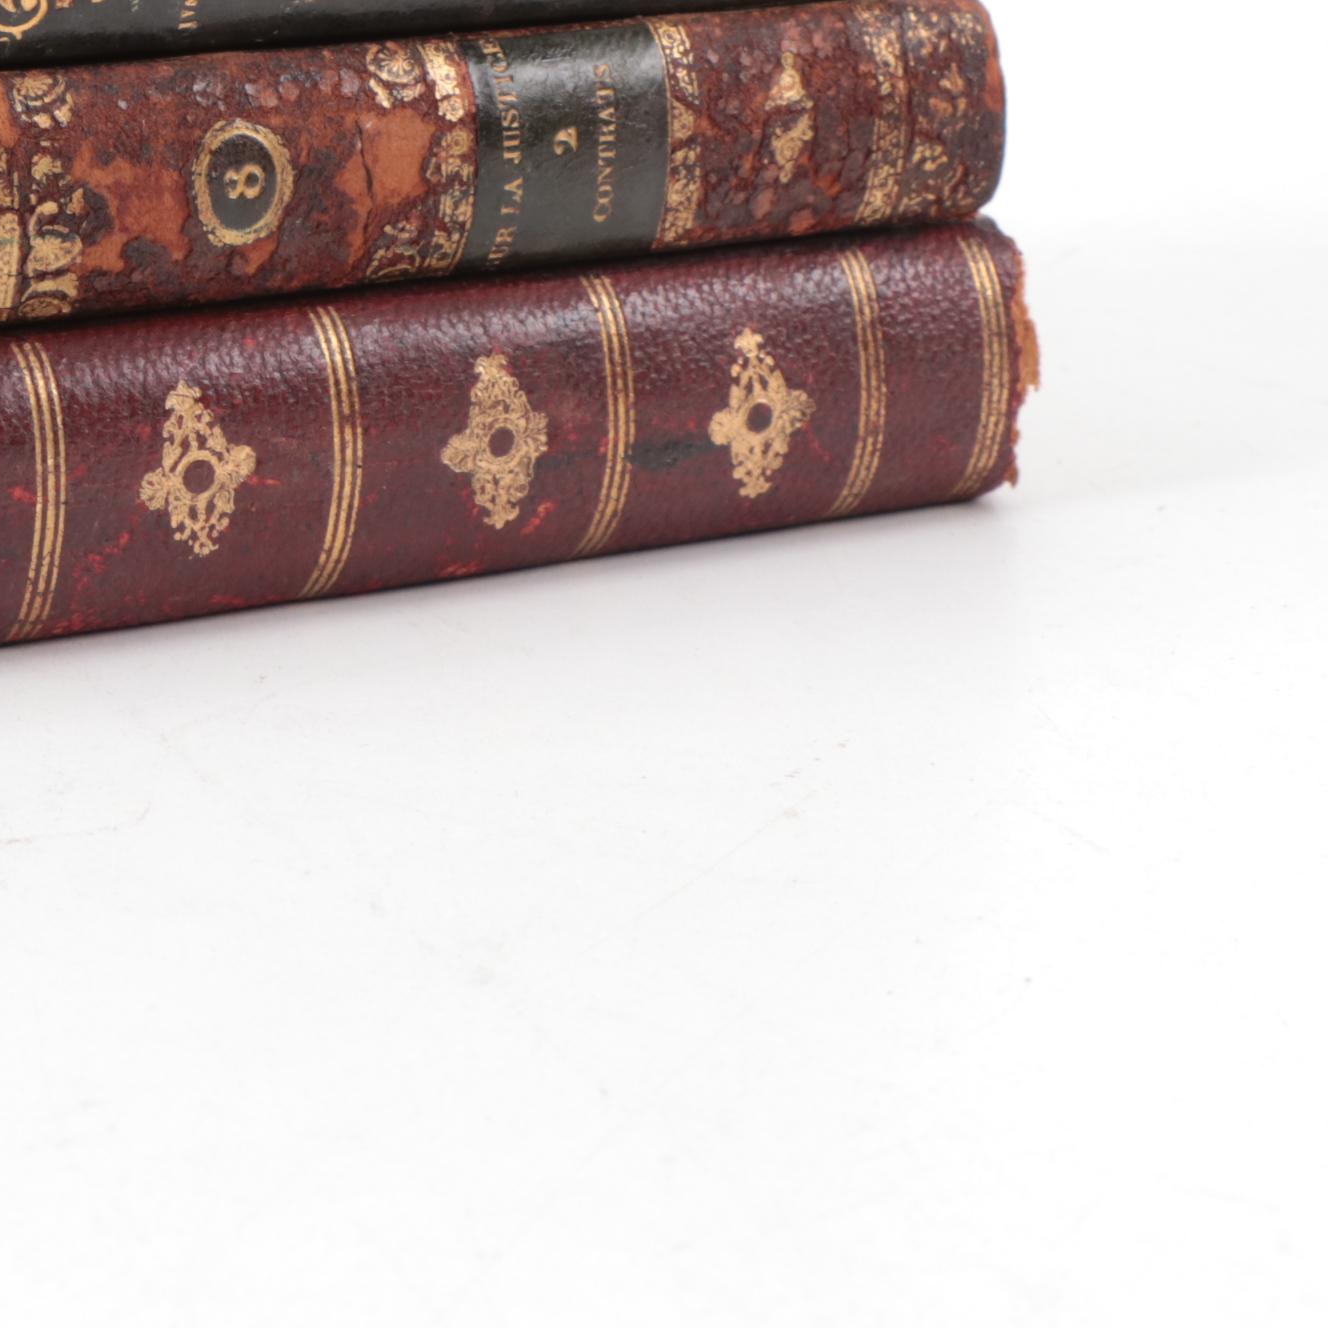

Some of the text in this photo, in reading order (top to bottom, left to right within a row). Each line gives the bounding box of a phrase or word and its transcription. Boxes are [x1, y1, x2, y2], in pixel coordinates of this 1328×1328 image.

[479, 38, 523, 165] JUSTICE
[553, 126, 579, 157] 2
[591, 63, 617, 222] CONTRATS
[223, 163, 266, 200] 8
[500, 176, 524, 215] LA
